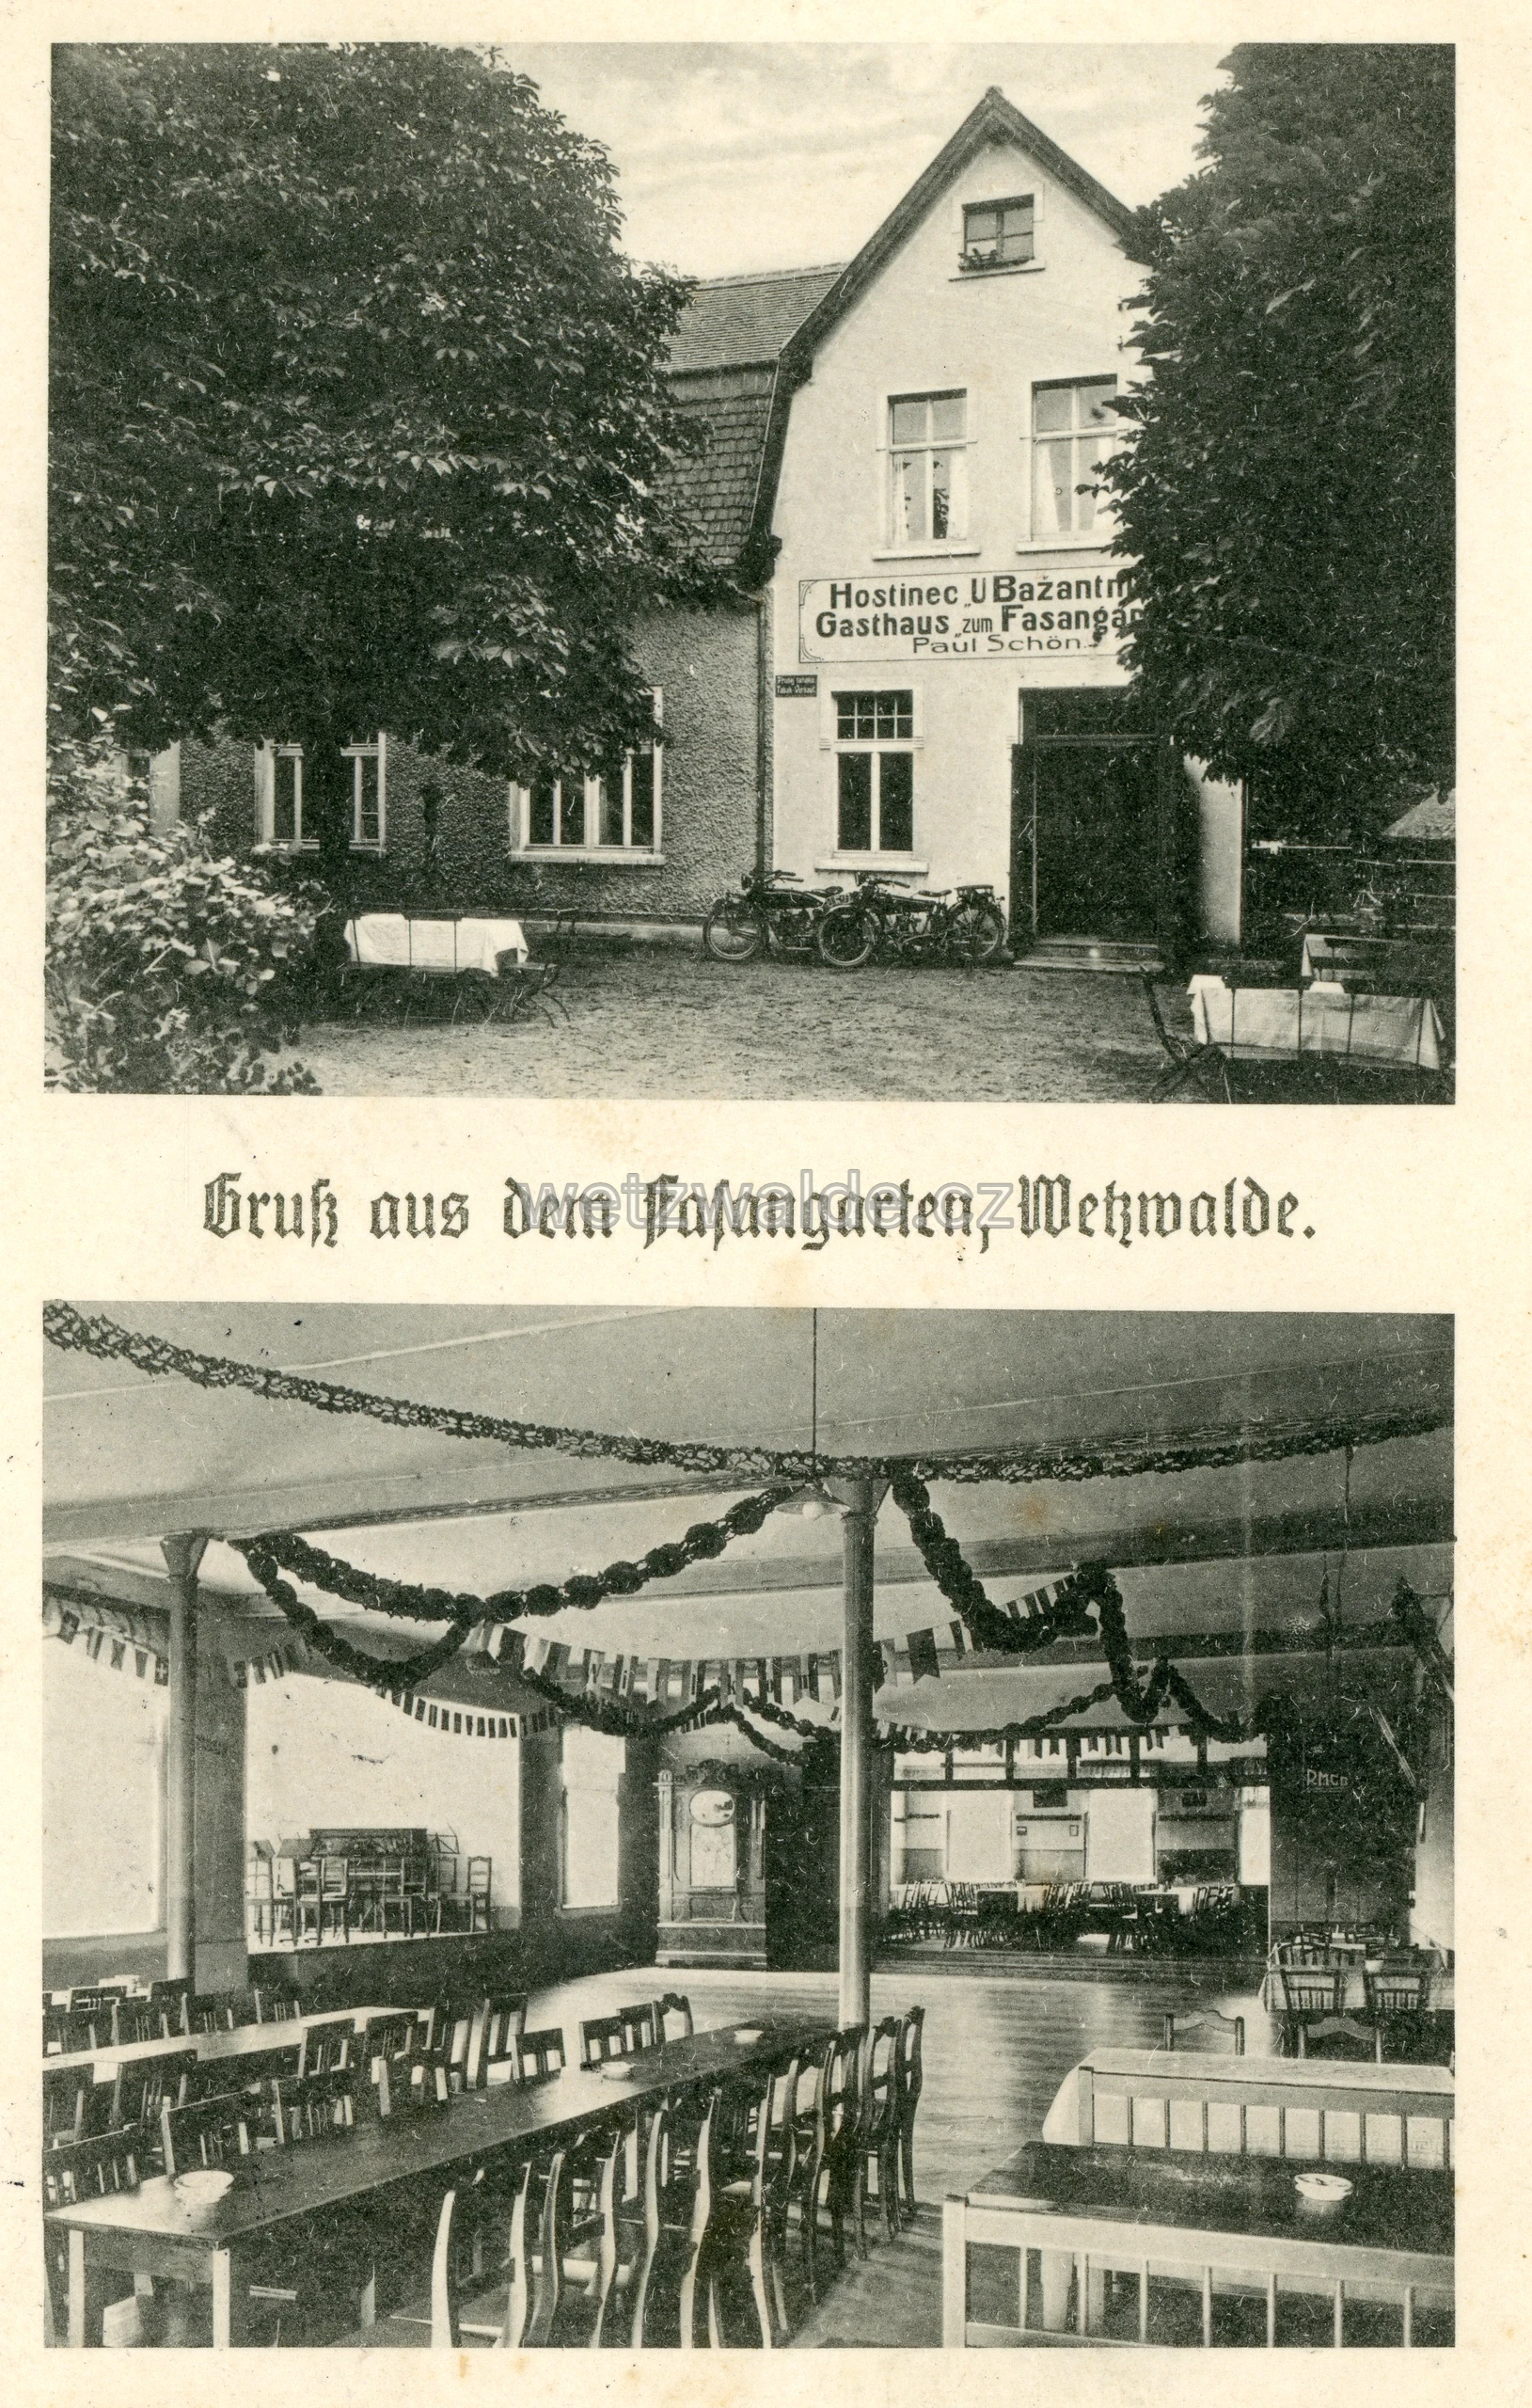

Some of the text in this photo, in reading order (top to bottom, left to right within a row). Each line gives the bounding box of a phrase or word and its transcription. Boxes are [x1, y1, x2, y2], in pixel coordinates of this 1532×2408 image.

[830, 583, 958, 610] Hostinec
[993, 575, 1132, 603] Bažantn
[815, 611, 950, 638] Gasthaus
[913, 634, 976, 654] Paul
[203, 1172, 339, 1248] Gruß
[370, 1189, 469, 1240] aus
[504, 1176, 613, 1240] dem
